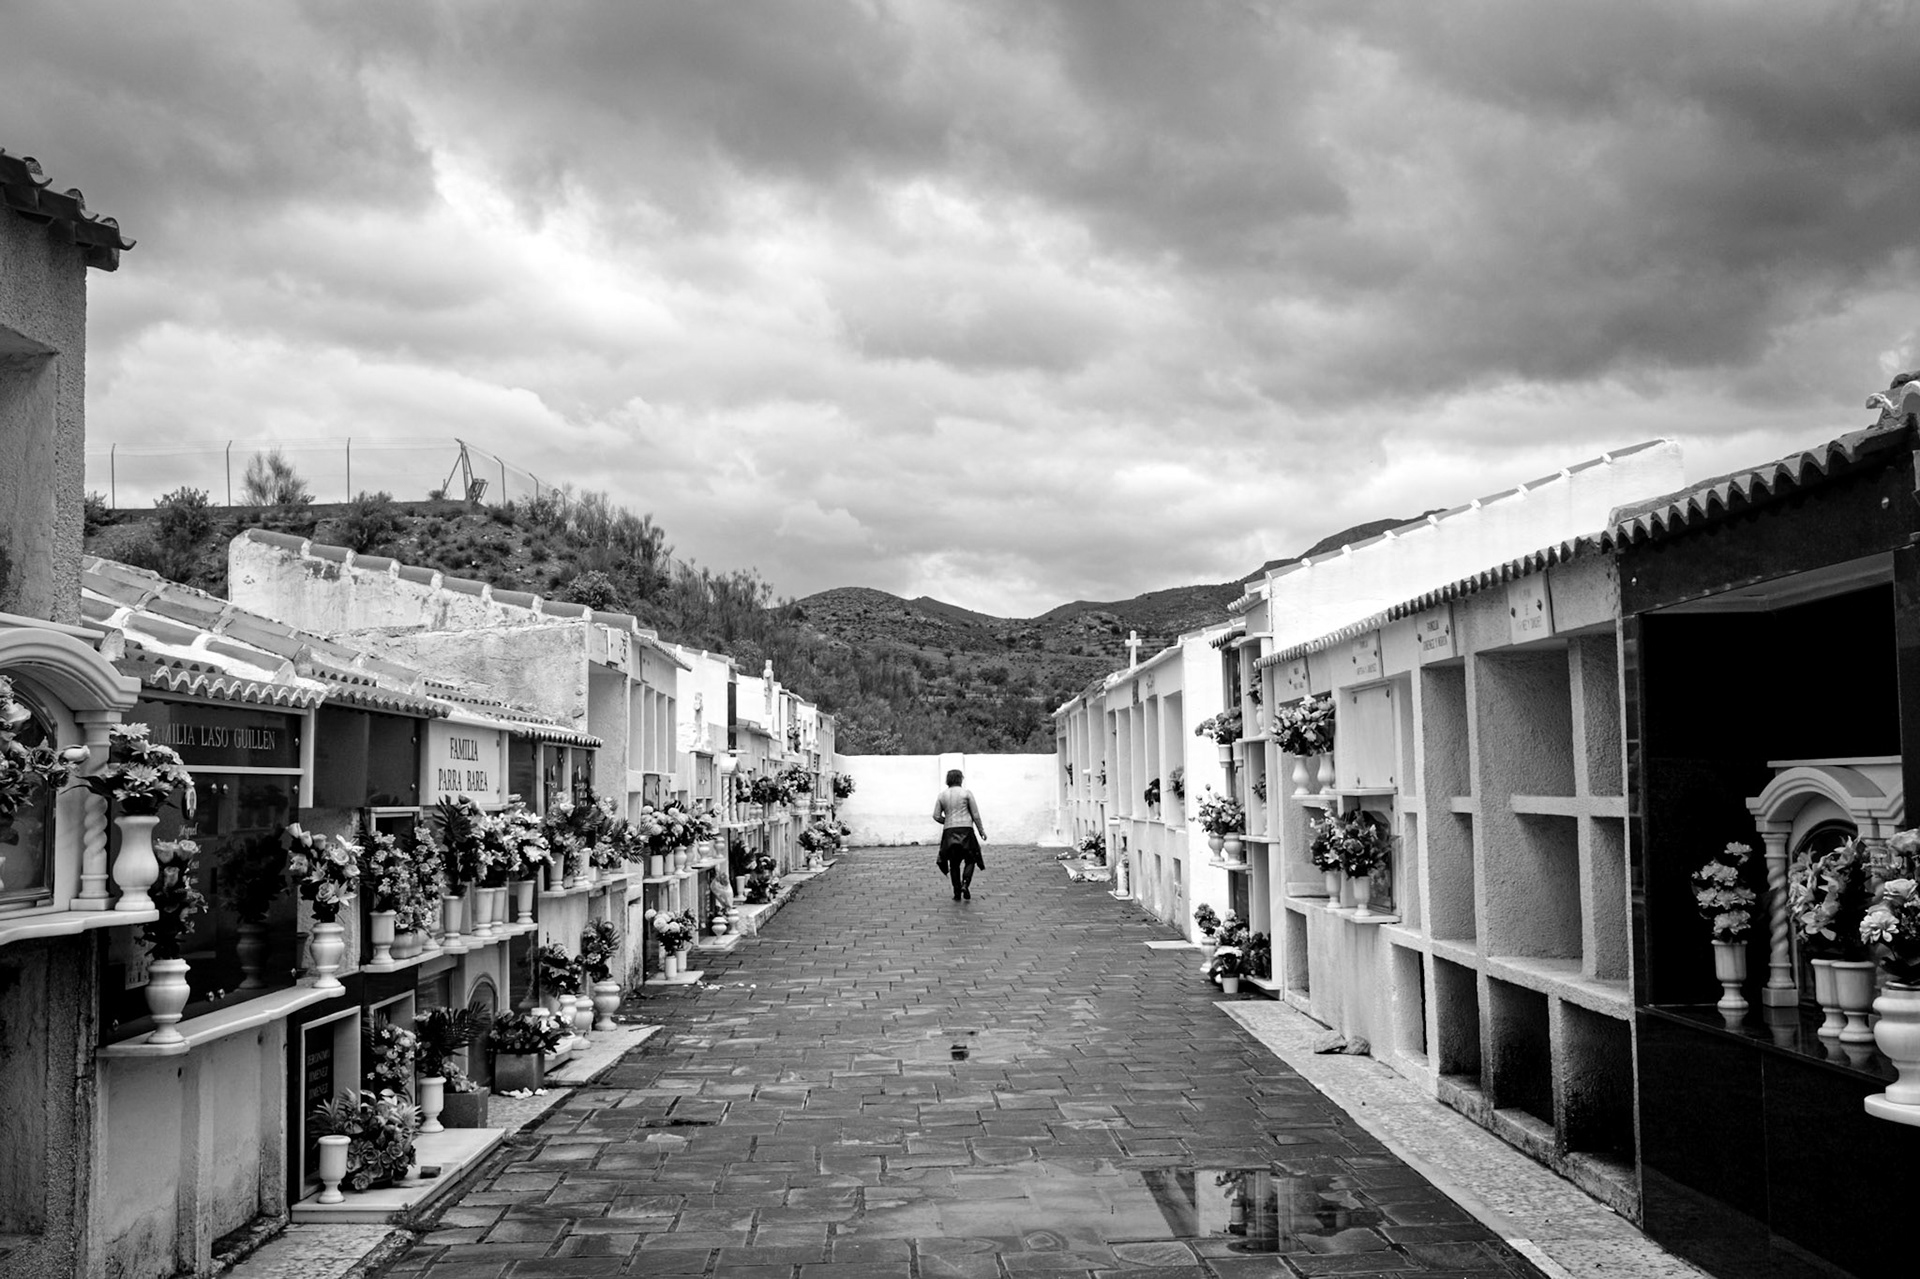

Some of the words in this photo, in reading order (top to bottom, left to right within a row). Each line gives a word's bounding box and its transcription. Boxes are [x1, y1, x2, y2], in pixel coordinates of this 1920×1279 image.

[149, 723, 195, 746] AMILIA
[200, 725, 229, 748] LASO
[233, 724, 276, 750] GUILLÉN
[449, 737, 479, 762] FAMILIA
[438, 768, 462, 791] PARRA
[467, 770, 488, 792] BAREA
